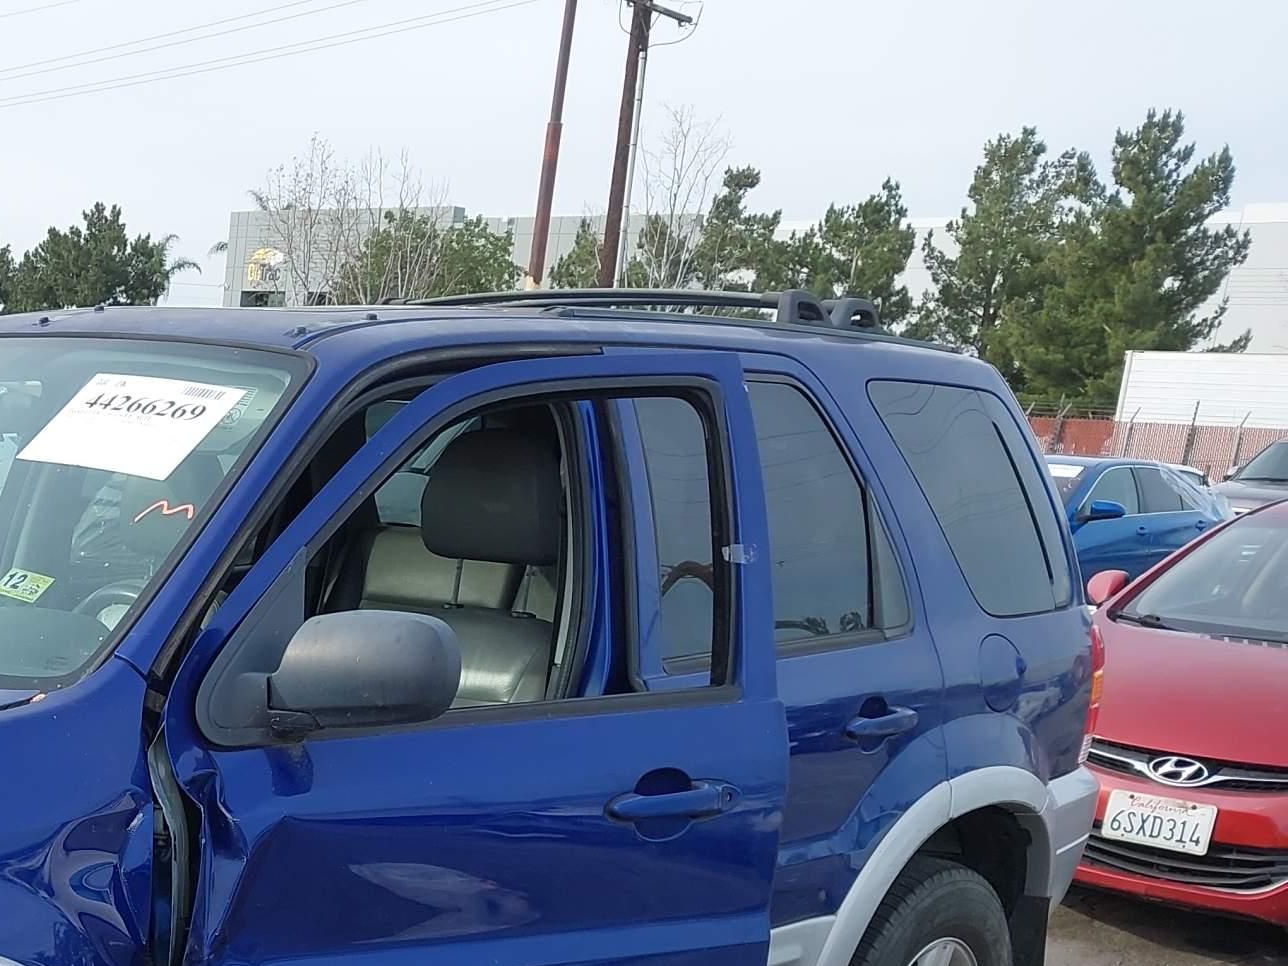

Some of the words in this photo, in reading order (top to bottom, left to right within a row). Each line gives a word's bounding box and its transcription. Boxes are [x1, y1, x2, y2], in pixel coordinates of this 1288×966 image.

[85, 393, 207, 420] 44266269
[3, 571, 28, 589] 12
[1130, 797, 1195, 816] California
[1110, 809, 1202, 847] 6SXD314
